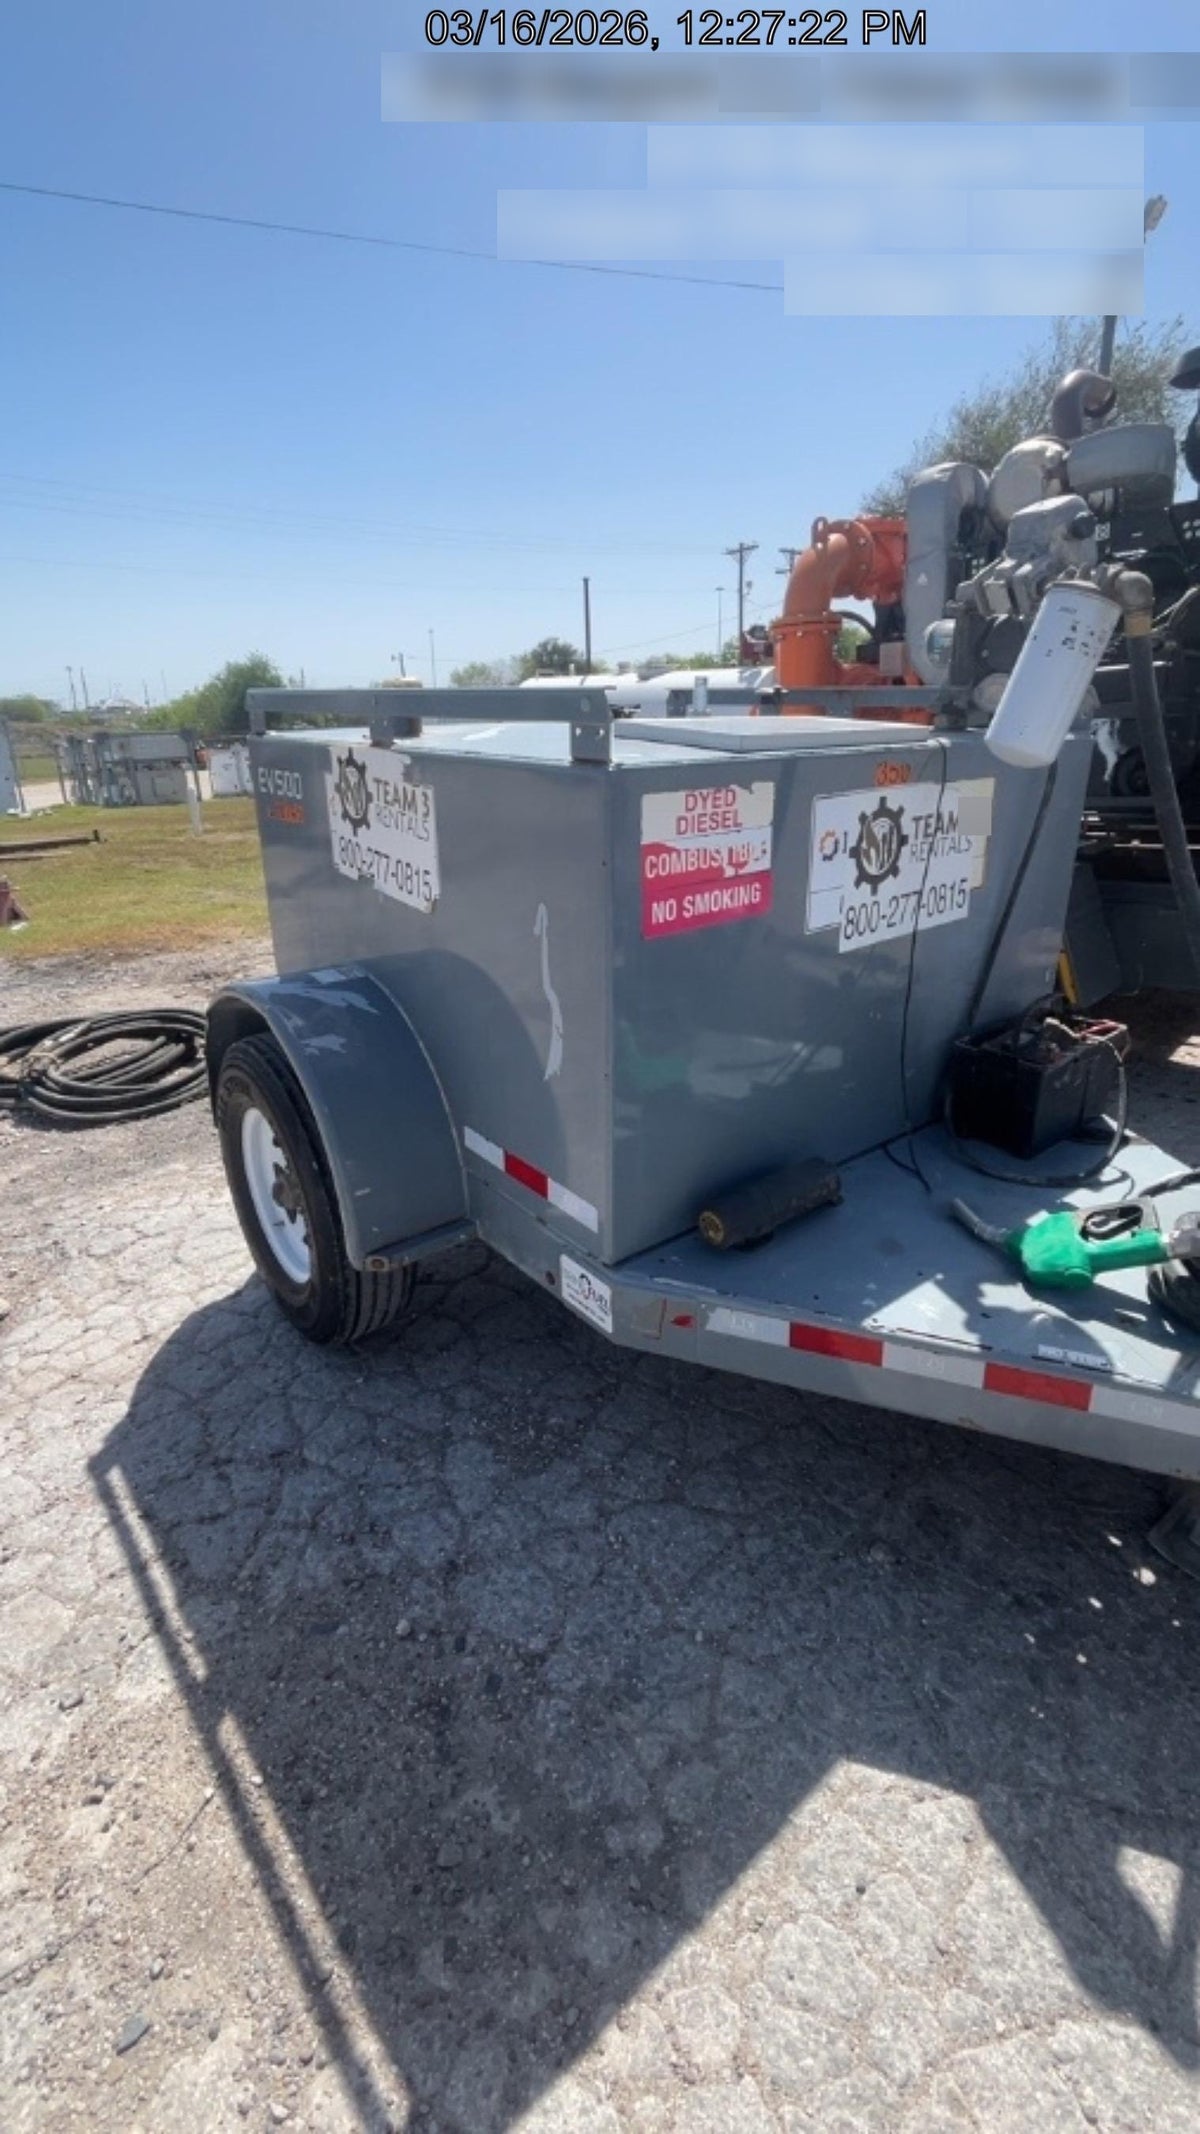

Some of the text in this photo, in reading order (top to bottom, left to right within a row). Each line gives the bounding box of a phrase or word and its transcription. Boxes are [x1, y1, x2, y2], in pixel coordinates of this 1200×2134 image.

[373, 776, 418, 817] TEAM
[421, 791, 430, 820] 3
[685, 788, 736, 812] DYED
[373, 802, 430, 843] RENTALS
[676, 810, 743, 835] DIESEL
[911, 810, 959, 839] TEAM
[339, 835, 432, 902] 800-277-0815
[910, 836, 973, 863] RENTALS
[652, 882, 762, 924] NO SMOKING
[844, 878, 968, 941] 800-277-0815
